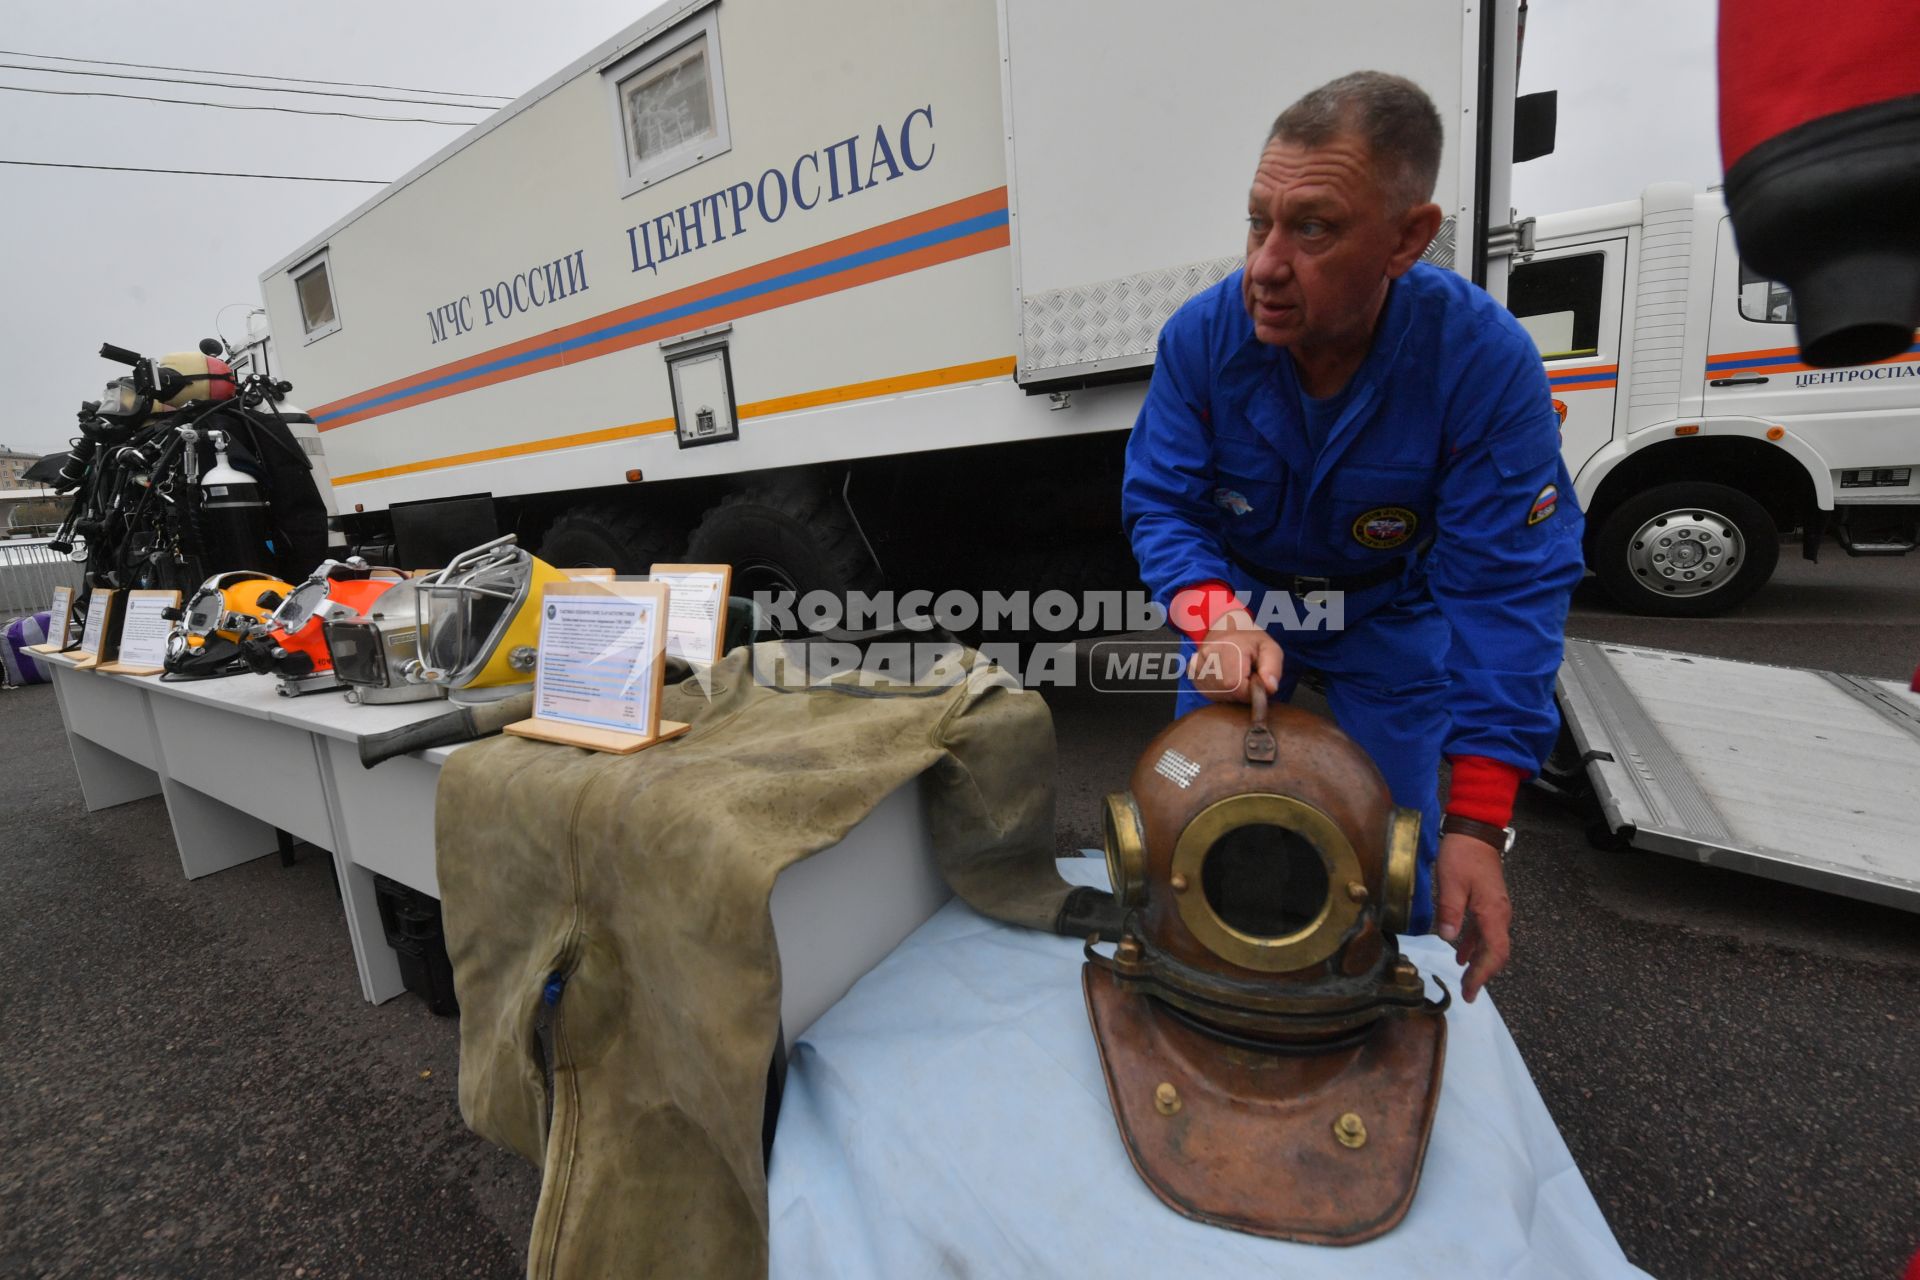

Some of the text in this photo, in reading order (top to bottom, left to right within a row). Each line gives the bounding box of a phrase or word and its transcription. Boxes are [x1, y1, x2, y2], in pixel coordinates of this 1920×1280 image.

[427, 103, 936, 345] МЧС РОССИИ ЦЕНТРОСПАС
